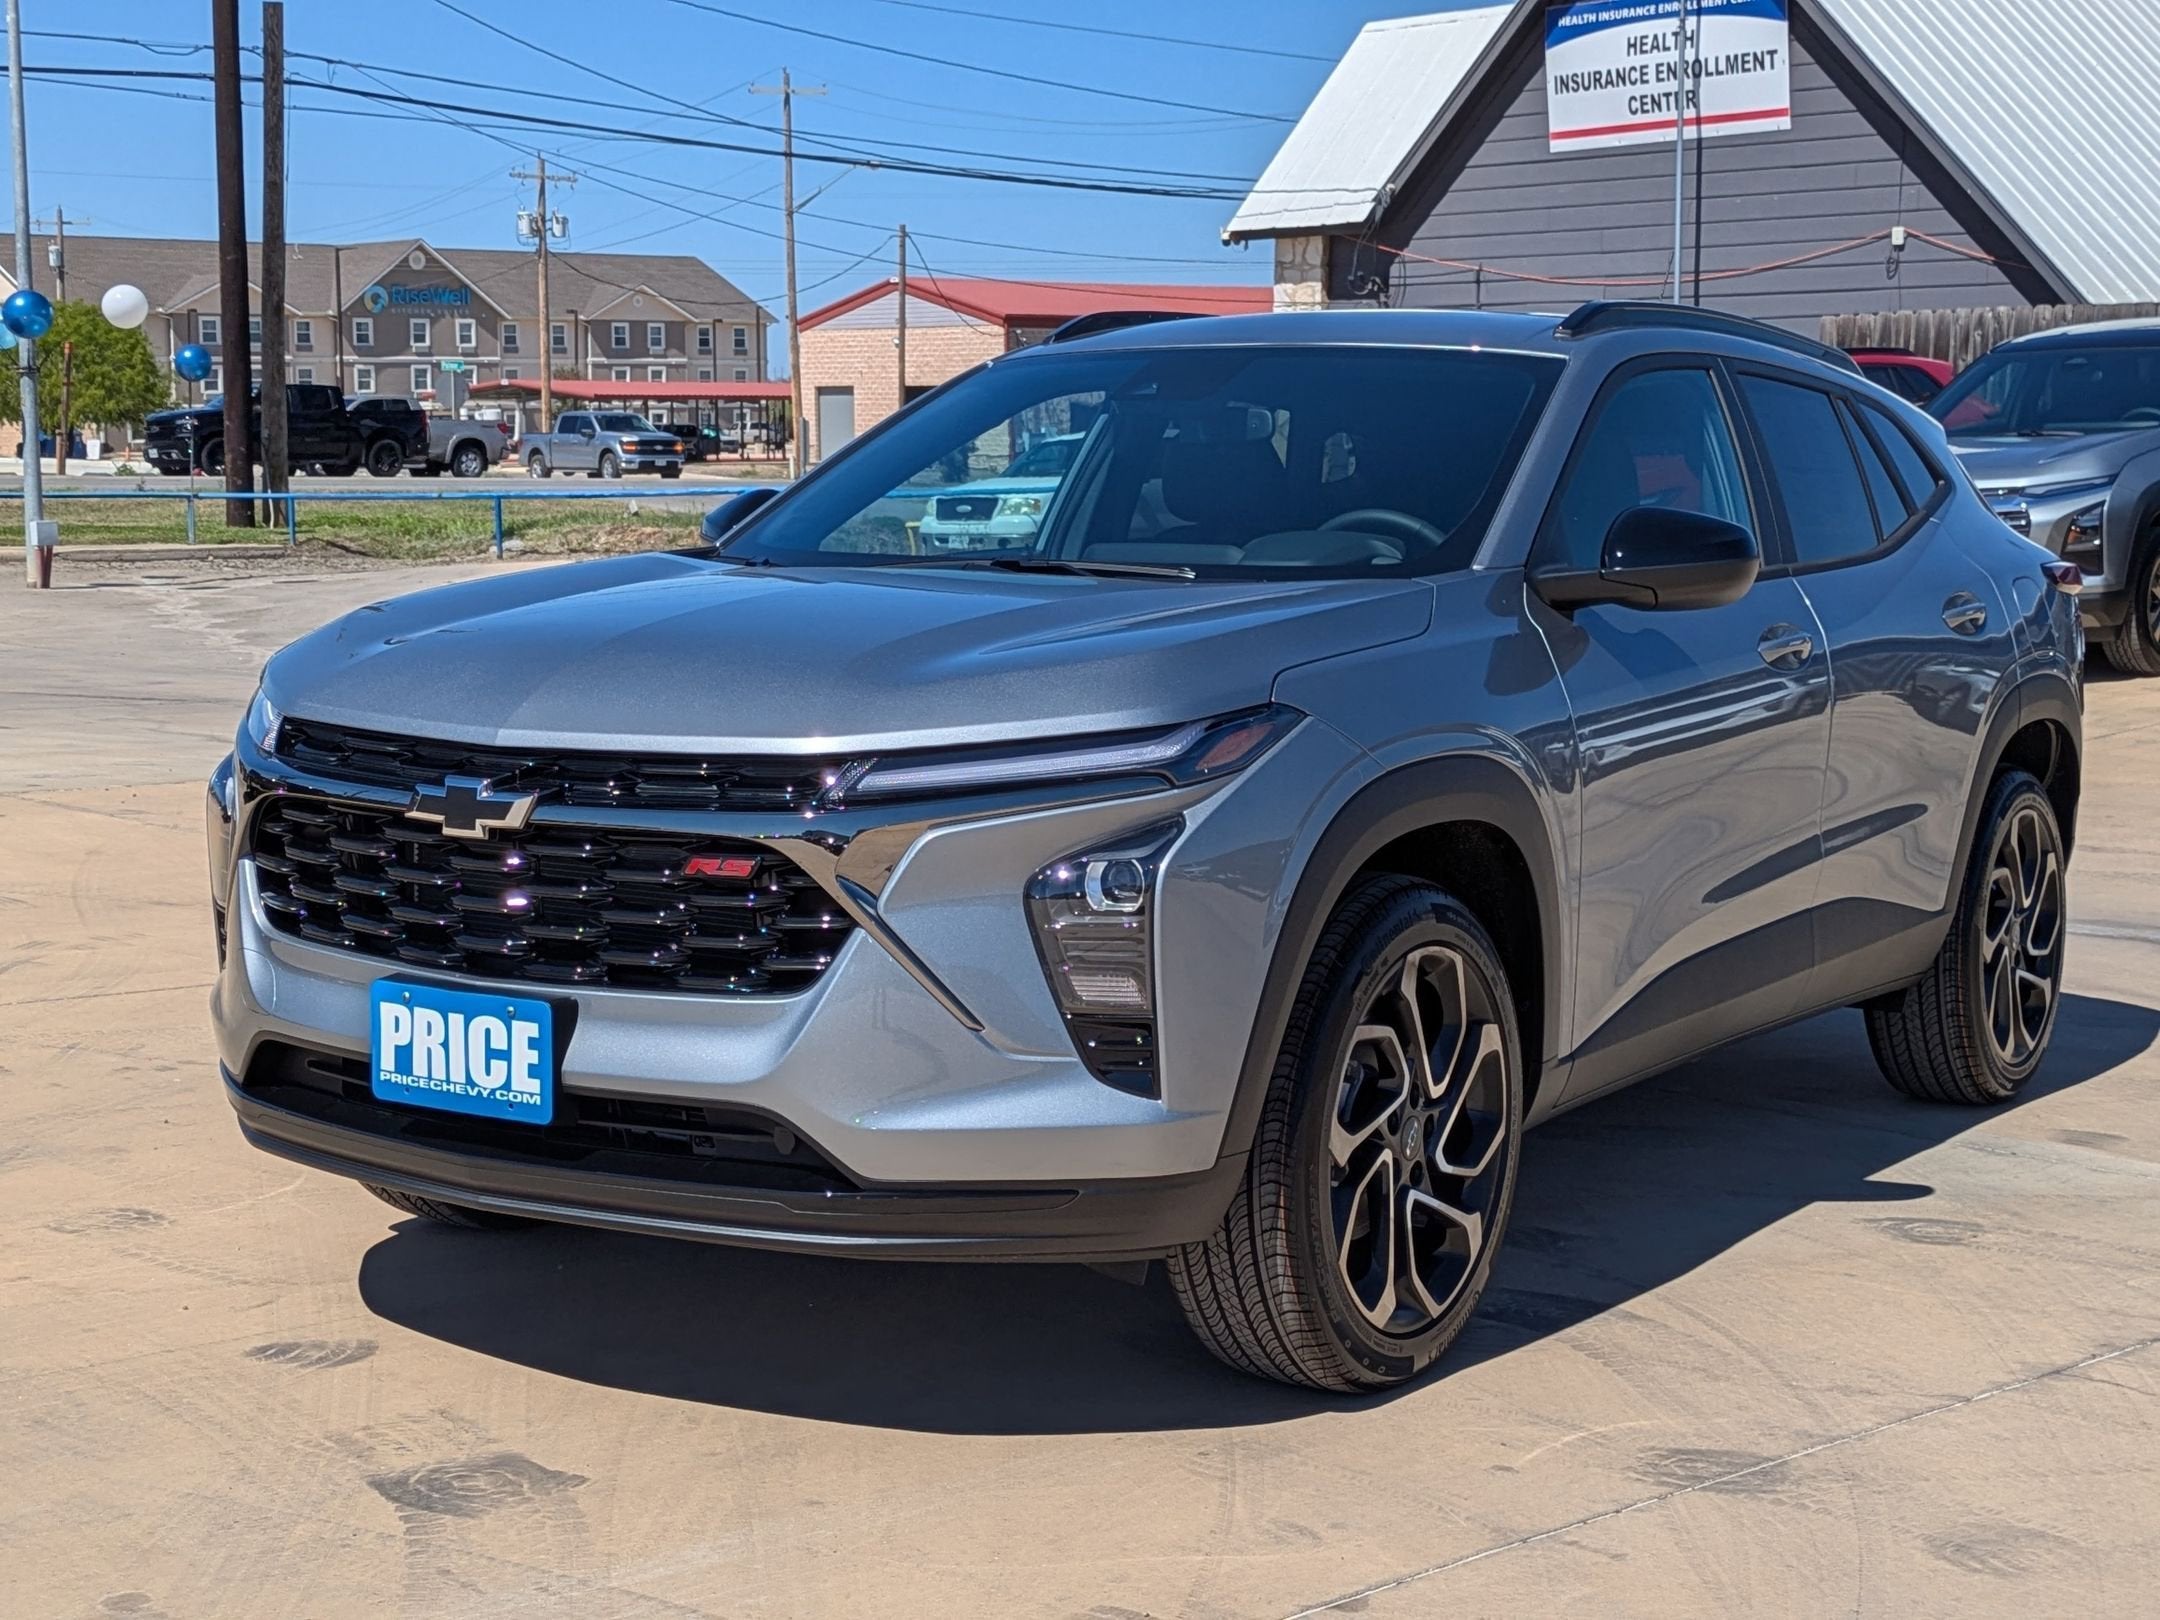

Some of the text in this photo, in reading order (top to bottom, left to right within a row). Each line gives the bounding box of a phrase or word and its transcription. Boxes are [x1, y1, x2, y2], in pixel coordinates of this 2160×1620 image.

[1558, 13, 1596, 27] HEALTH
[1598, 4, 1656, 21] INSURANCE
[1626, 29, 1695, 57] HEALTH
[1554, 49, 1778, 95] INSURANCE ENROLLMENT
[392, 286, 470, 306] RiseWell
[685, 858, 755, 877] RS
[380, 1001, 541, 1094] PRICE
[380, 1071, 541, 1106] PRICECHEVY.COM
